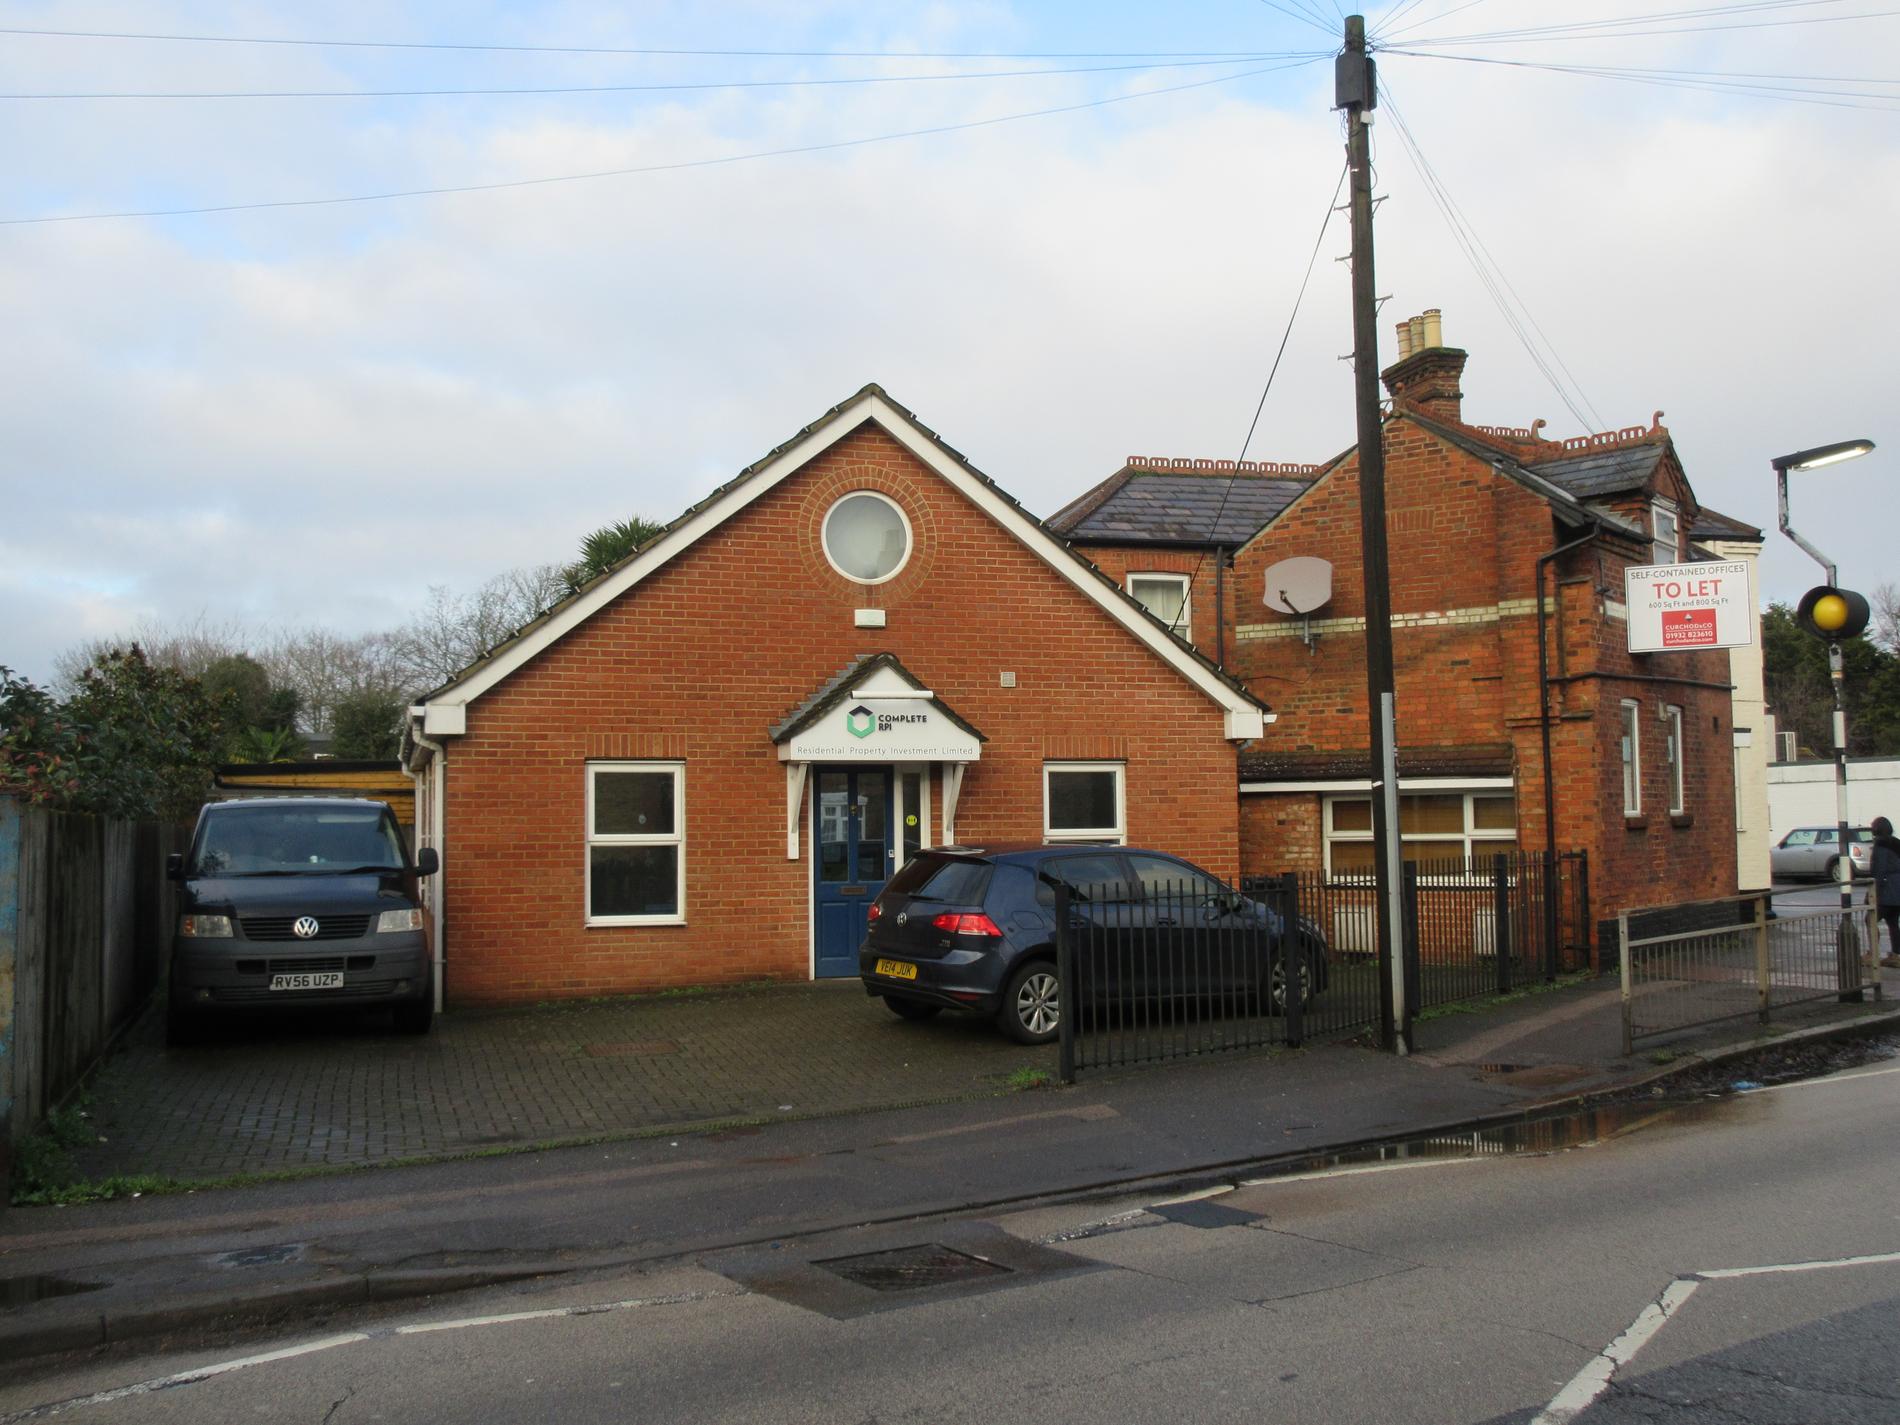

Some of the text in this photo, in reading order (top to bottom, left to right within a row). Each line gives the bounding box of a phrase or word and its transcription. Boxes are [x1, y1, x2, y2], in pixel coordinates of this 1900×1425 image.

[1630, 565, 1745, 580] SELF-CONTAINED OFFICES
[1652, 579, 1722, 599] TO LET
[878, 714, 927, 723] COMPLETE
[878, 723, 892, 731] RPI
[797, 746, 973, 756] Residential Property Investment Limited
[275, 974, 339, 988] RV56 UZP
